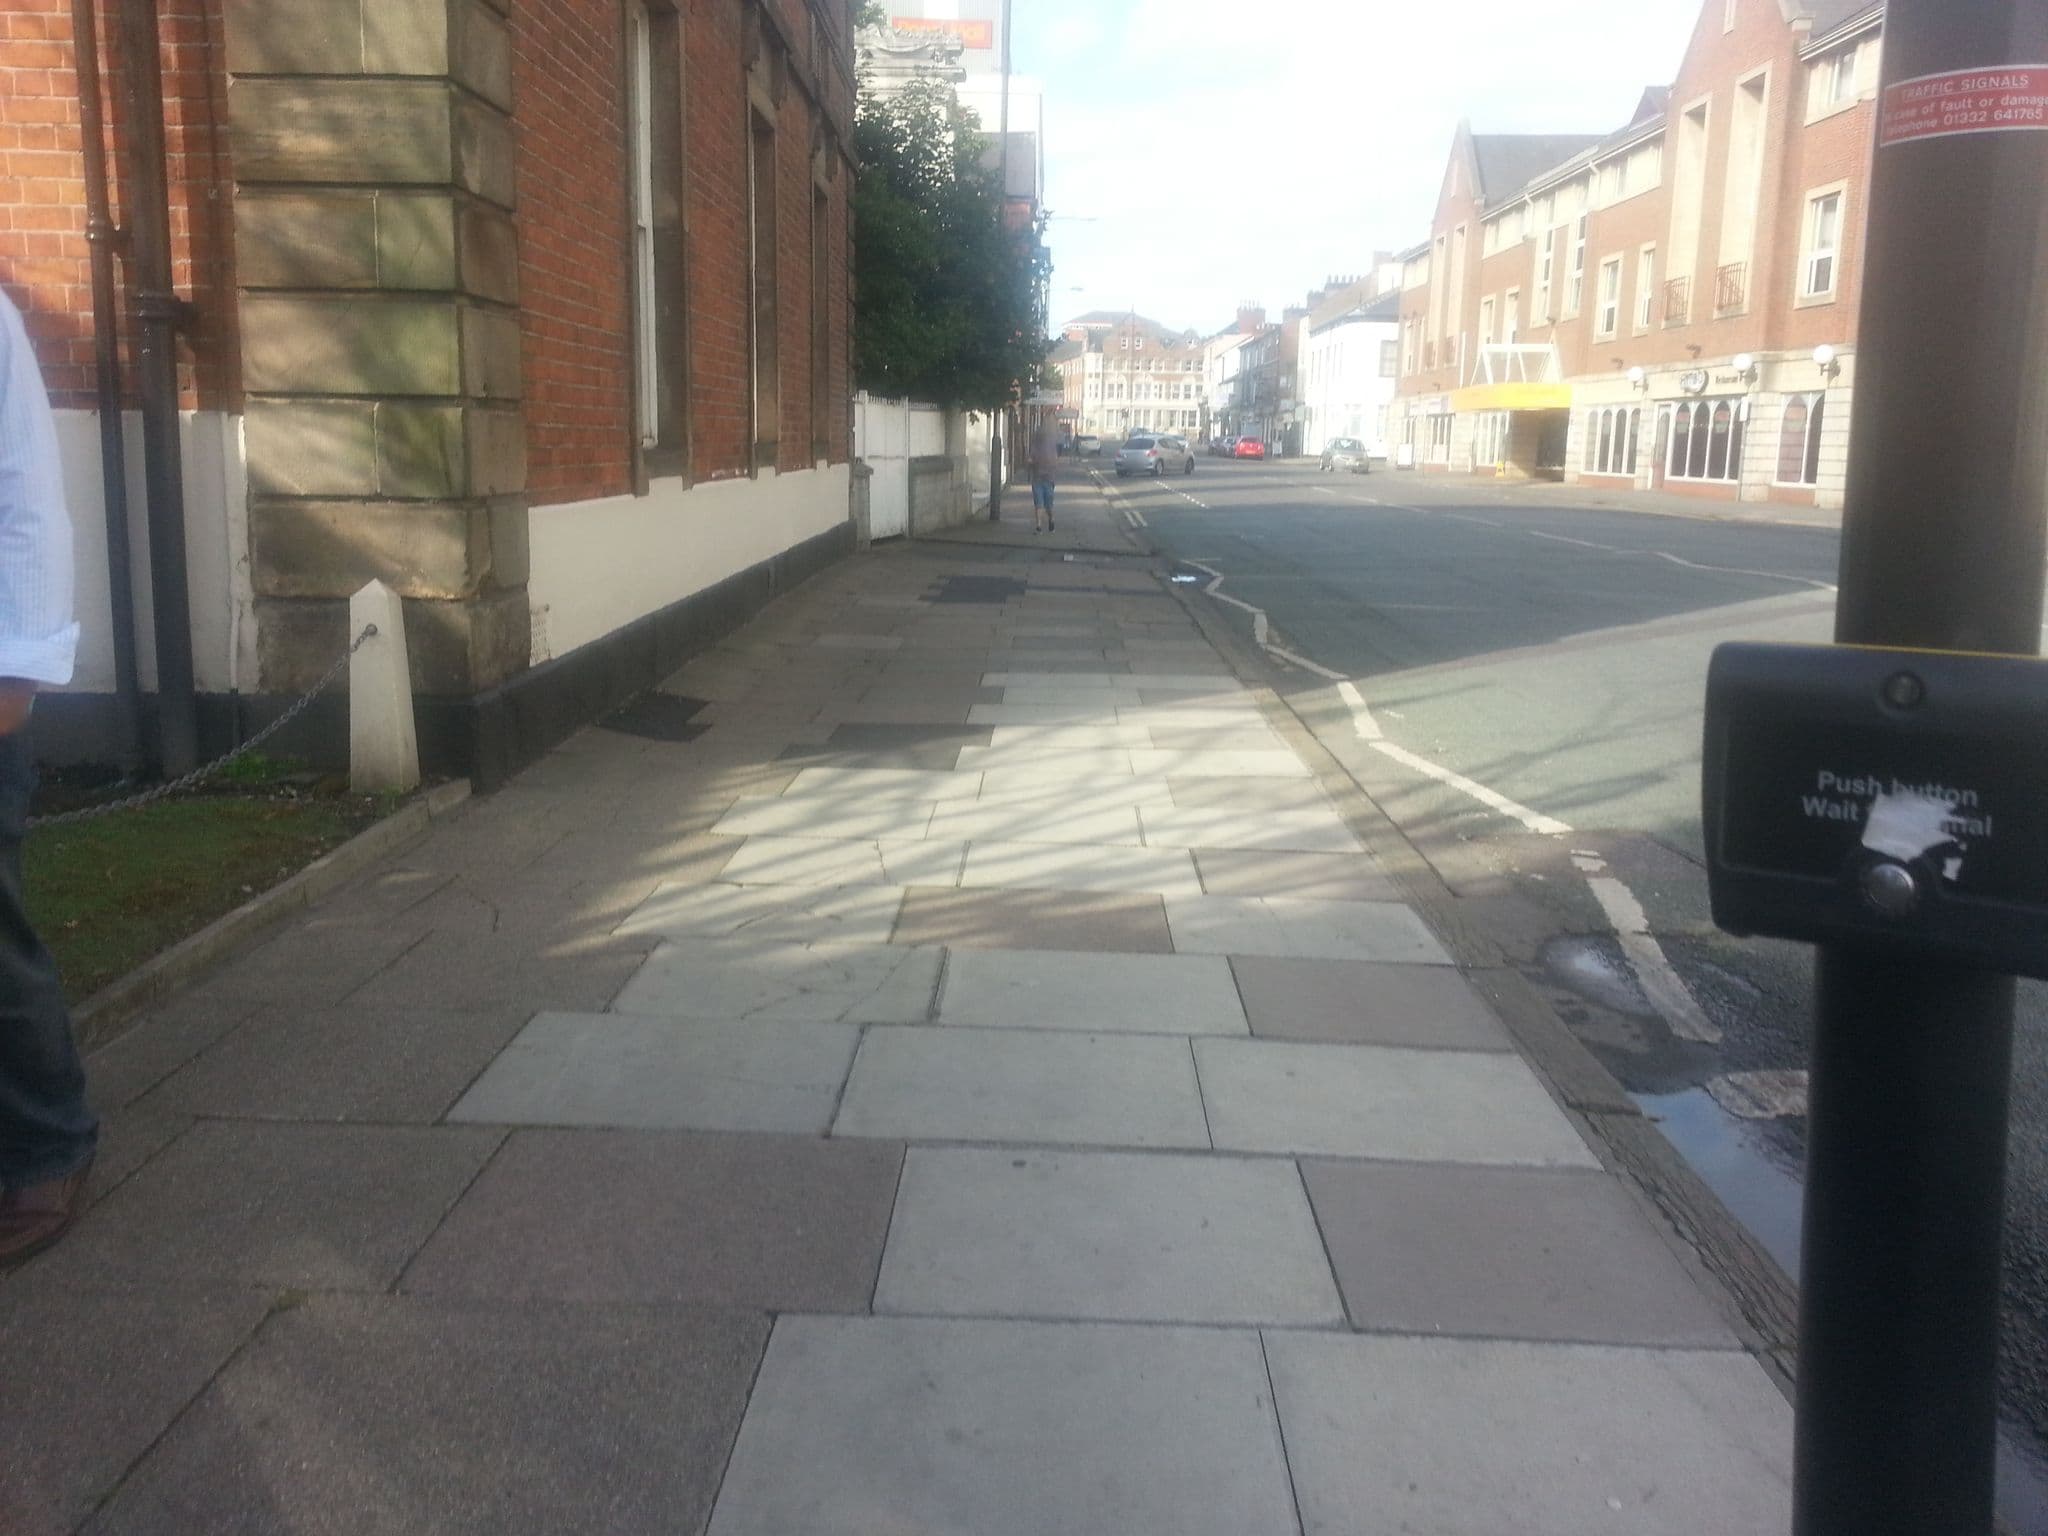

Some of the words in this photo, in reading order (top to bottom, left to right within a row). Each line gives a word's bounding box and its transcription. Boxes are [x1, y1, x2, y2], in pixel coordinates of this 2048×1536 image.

[1903, 81, 1954, 97] TRAFFIC
[1961, 75, 2029, 90] SIGNALS
[1922, 103, 1936, 115] of
[1940, 97, 1973, 112] fault
[1979, 98, 1994, 108] or
[1943, 110, 1987, 126] 01332
[1993, 108, 2043, 120] 641765
[1817, 770, 1883, 796] Push
[1891, 777, 1979, 807] button
[1801, 795, 1859, 822] Wait
